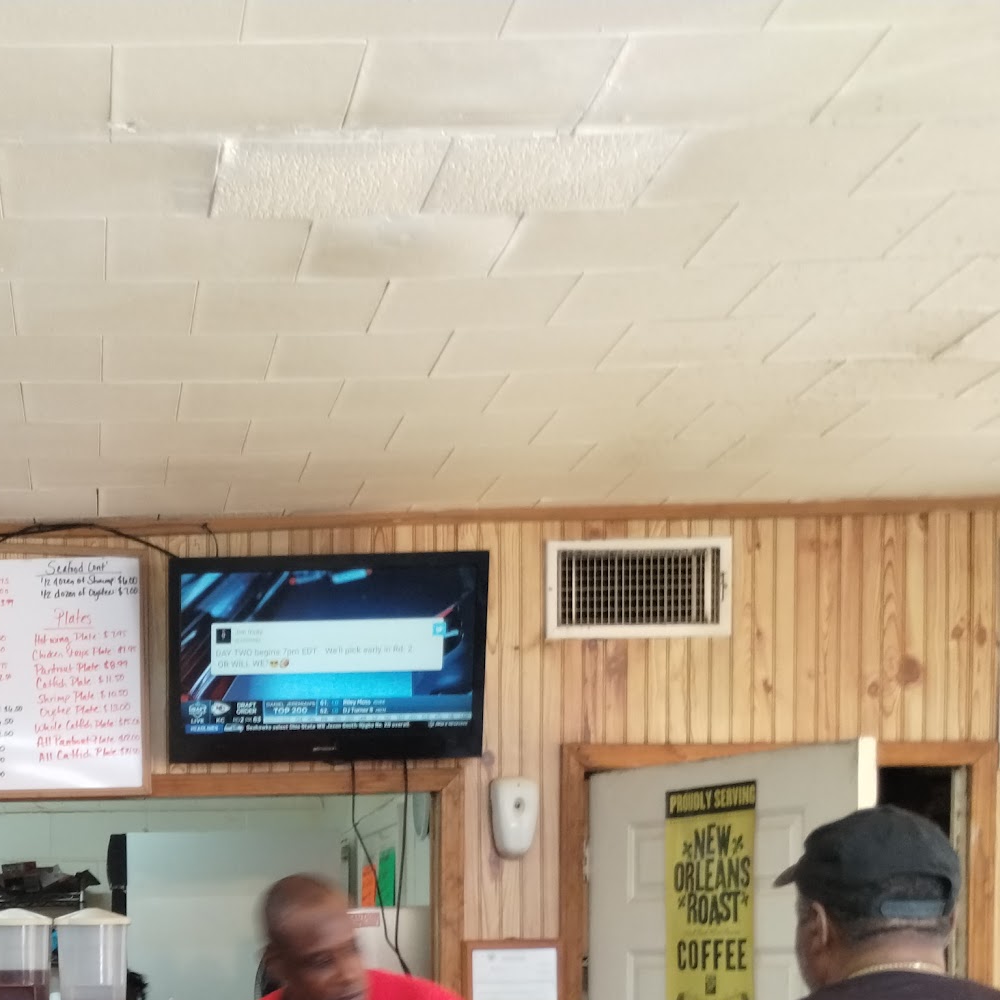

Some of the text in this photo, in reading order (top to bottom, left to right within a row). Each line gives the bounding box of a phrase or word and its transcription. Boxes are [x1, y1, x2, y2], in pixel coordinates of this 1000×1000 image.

[53, 608, 92, 628] Plates
[273, 706, 308, 715] TOP 200
[669, 784, 756, 813] PROUDLY SERVING
[693, 822, 732, 861] NEW
[673, 854, 751, 893] ORLEANS
[687, 891, 740, 925] ROAST
[677, 937, 748, 972] COFFEE
